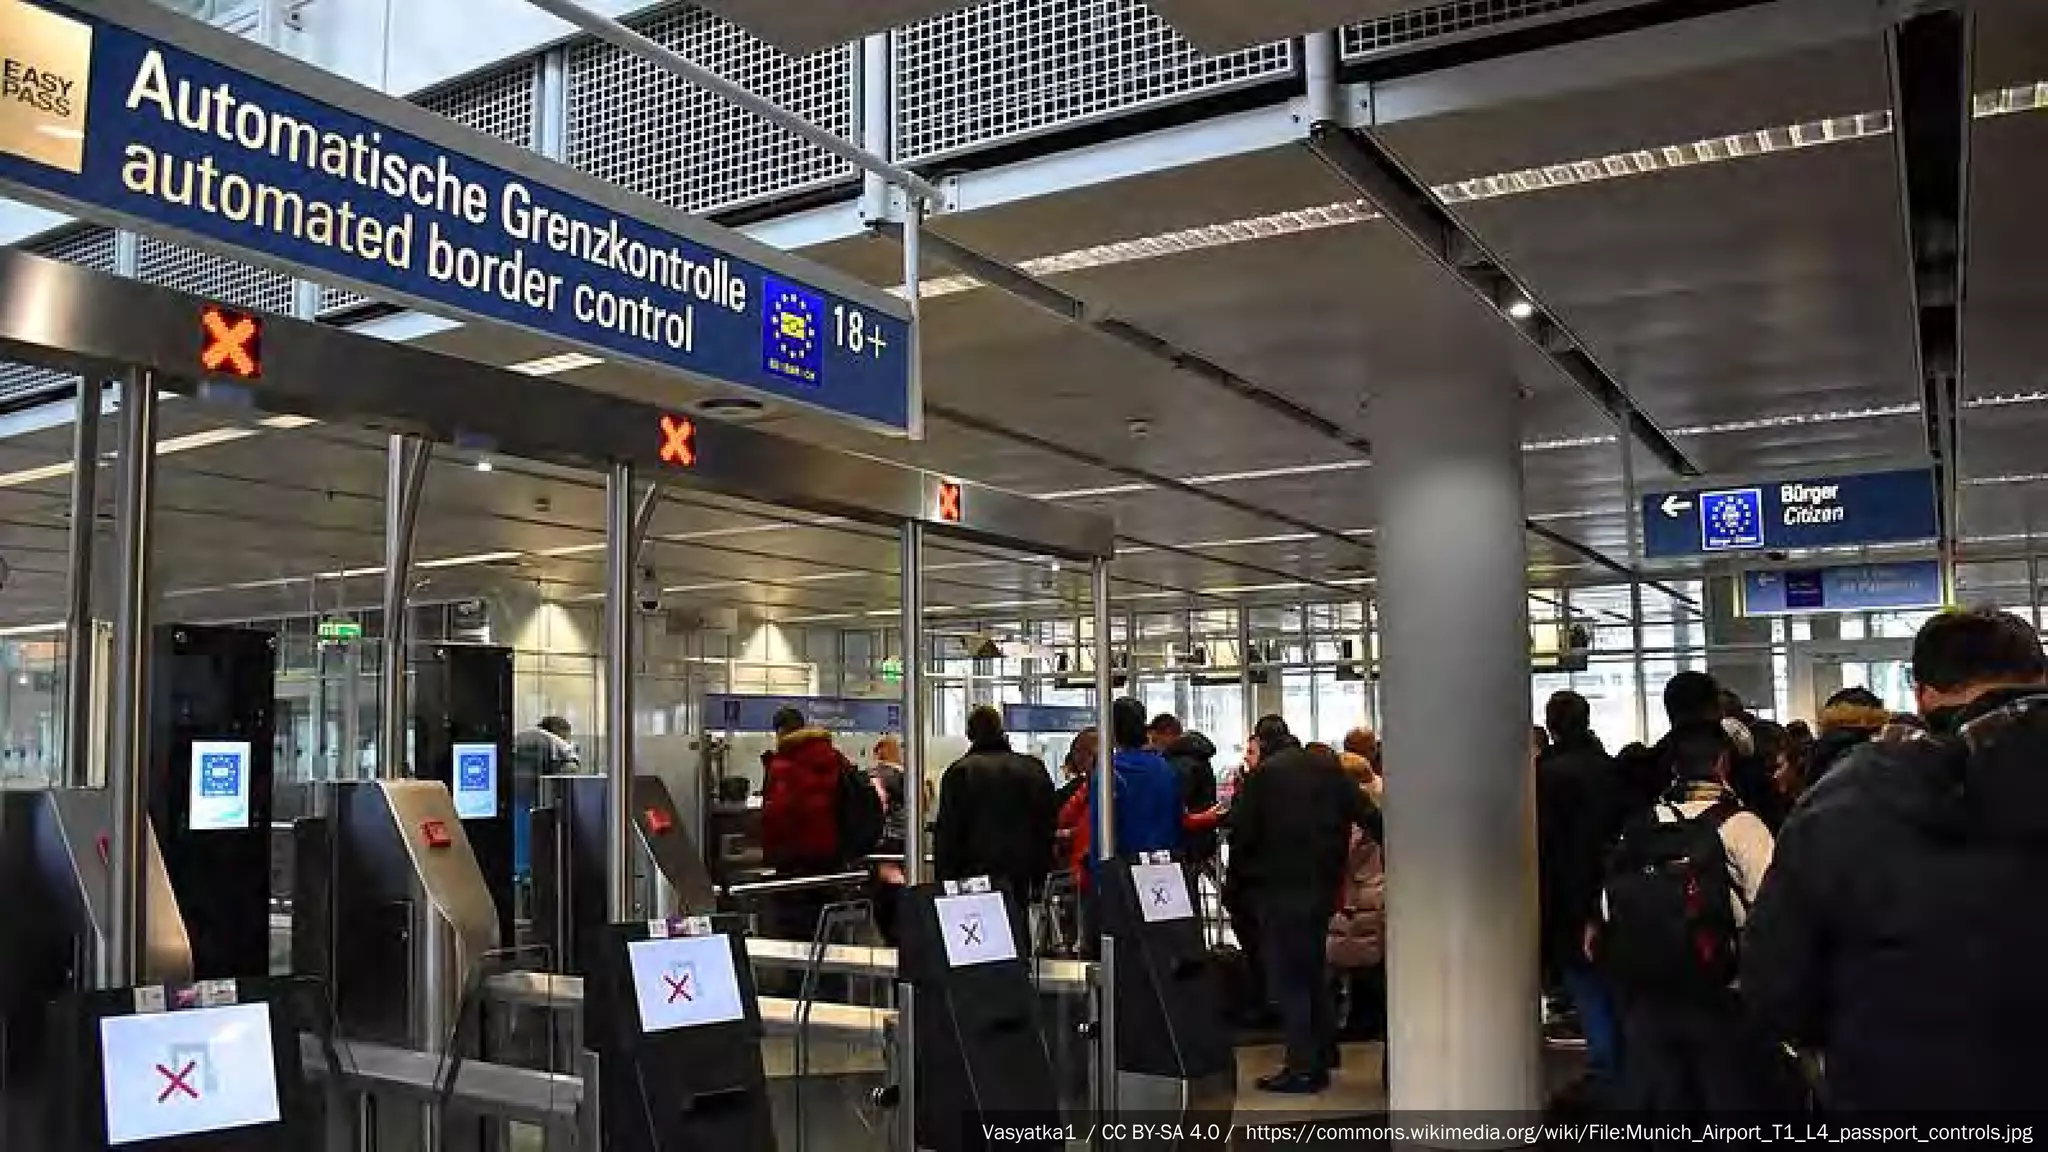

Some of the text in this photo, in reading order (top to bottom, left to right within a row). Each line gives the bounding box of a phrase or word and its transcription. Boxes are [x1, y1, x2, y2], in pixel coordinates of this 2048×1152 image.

[3, 78, 70, 118] PASS
[4, 58, 74, 97] EASY
[125, 49, 747, 313] Automatische Grenzkontrolle
[121, 141, 693, 352] automated border control
[834, 304, 888, 358] 18+
[1781, 484, 1839, 505] Bürger
